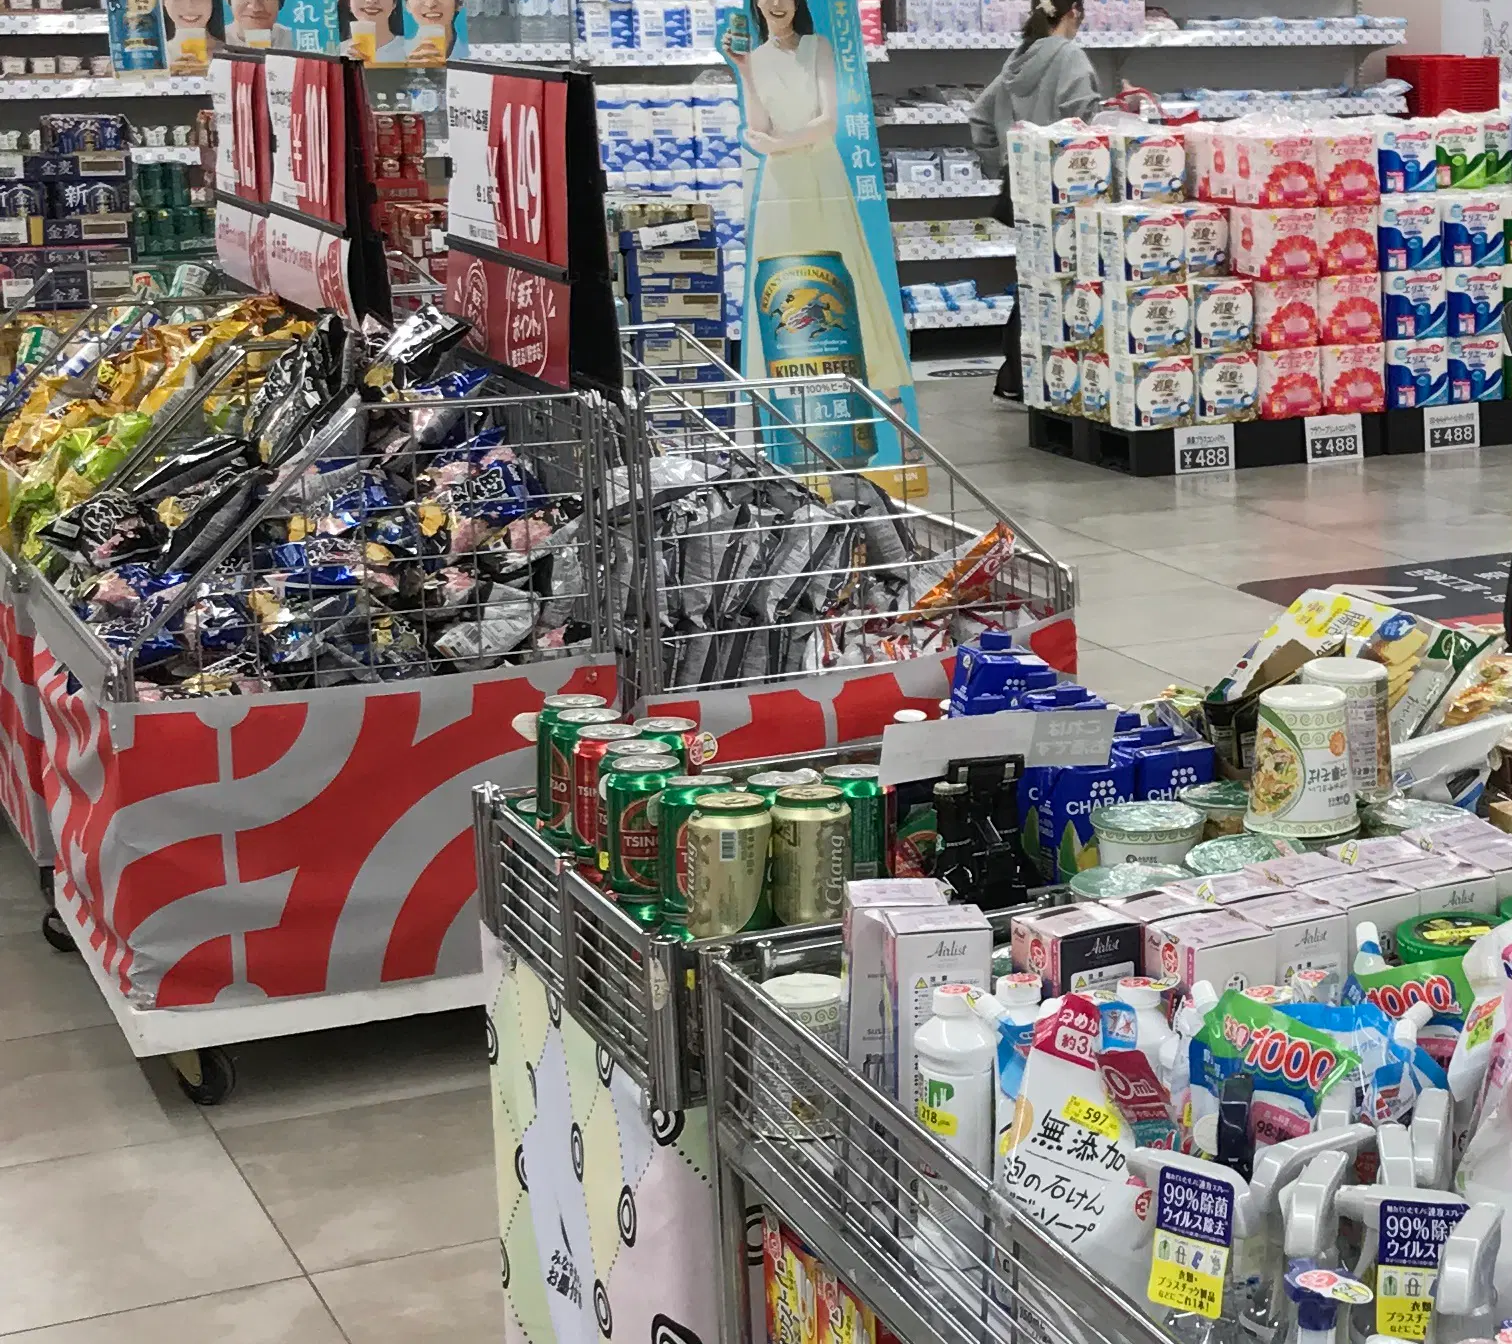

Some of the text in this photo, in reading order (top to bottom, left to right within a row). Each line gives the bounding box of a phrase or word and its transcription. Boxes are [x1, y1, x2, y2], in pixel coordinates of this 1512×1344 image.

[41, 160, 74, 176] 金麦
[844, 111, 883, 203] 晴れ風
[820, 833, 848, 906] Chang
[928, 940, 968, 958] Airlist
[1245, 1026, 1338, 1091] 1000
[1031, 1109, 1127, 1172] 無添加
[1003, 1154, 1105, 1216] 泡の石けん
[1163, 1182, 1229, 1220] 99%除菌
[1161, 1206, 1227, 1238] ウイルス除去
[1387, 1240, 1440, 1259] ウイルス
